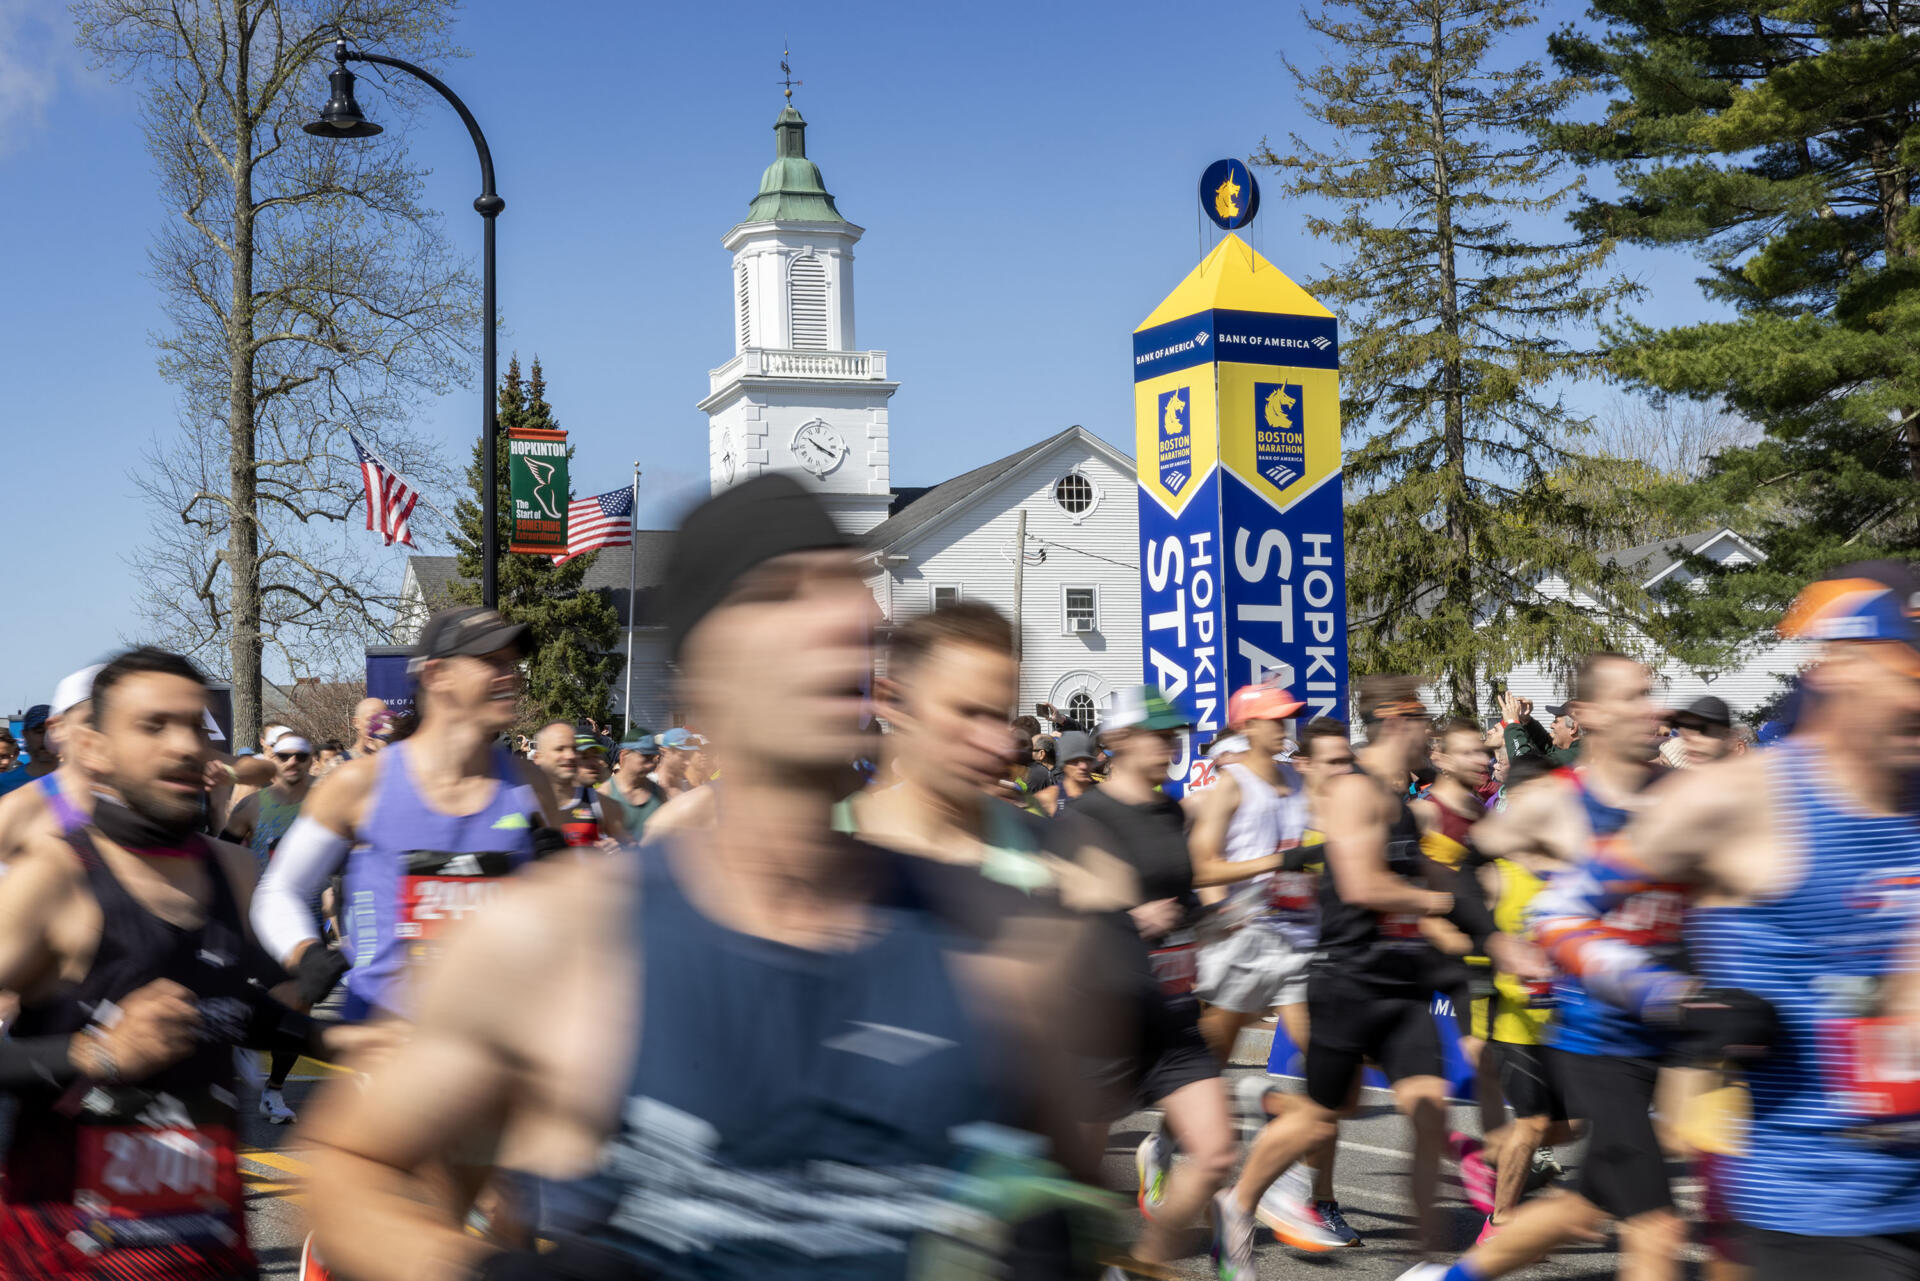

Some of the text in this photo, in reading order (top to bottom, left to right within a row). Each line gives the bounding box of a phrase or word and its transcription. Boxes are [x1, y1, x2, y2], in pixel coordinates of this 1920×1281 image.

[1219, 334, 1310, 349] BANK OF AMERICA
[1136, 340, 1195, 365] BANK OF AMERICA
[1160, 435, 1190, 452] BOSTON
[1257, 431, 1303, 444] BOSTON
[511, 441, 566, 456] HOPKINTON
[1160, 447, 1190, 462] MARATHON
[1258, 443, 1303, 454] MARATHON
[516, 499, 529, 509] The
[516, 509, 541, 519] Start of
[1234, 526, 1297, 741] STA
[1189, 531, 1217, 755] HOPKIN
